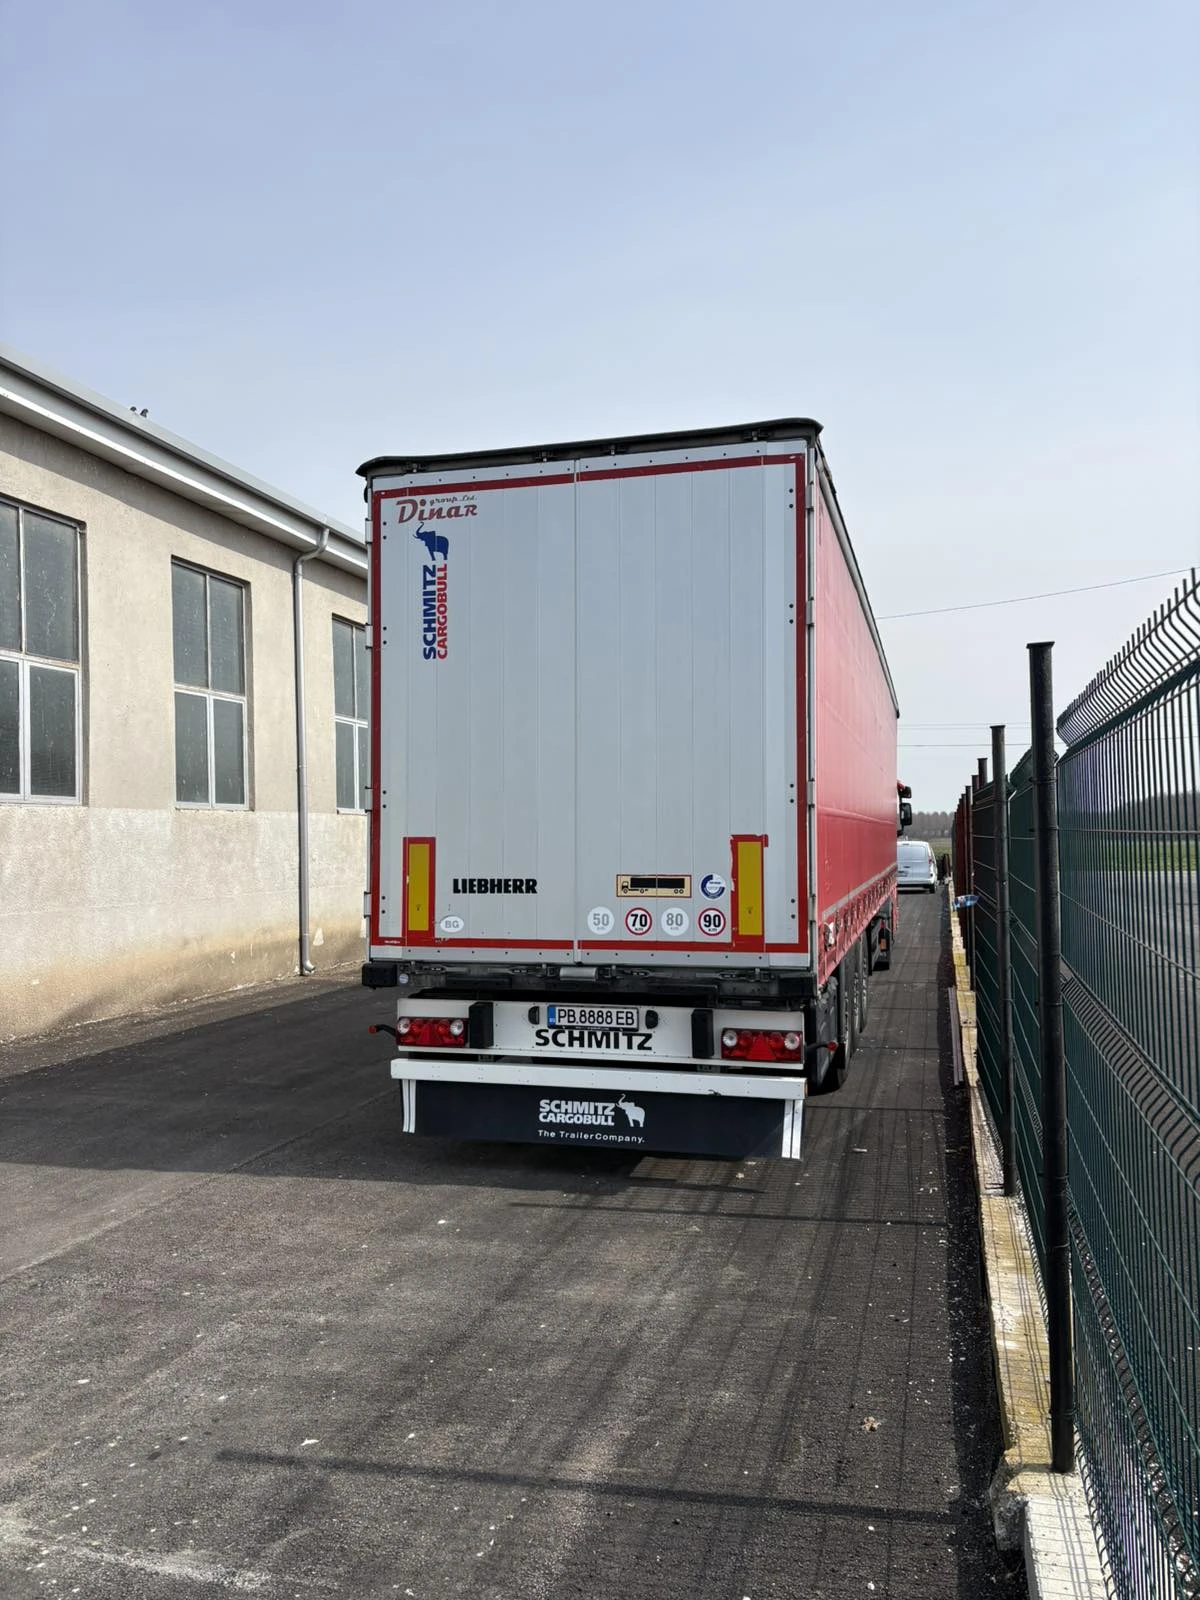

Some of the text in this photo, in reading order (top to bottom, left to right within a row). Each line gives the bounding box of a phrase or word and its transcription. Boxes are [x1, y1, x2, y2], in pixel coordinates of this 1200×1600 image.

[422, 564, 437, 660] SCHMITZ
[436, 563, 448, 660] CARGOBULL
[452, 878, 538, 894] LIEBHERR
[444, 920, 460, 929] BG
[592, 912, 610, 927] 50
[630, 913, 648, 928] 70
[666, 912, 684, 927] 80
[703, 913, 721, 928] 90
[535, 1028, 653, 1051] SCHMITZ
[539, 1099, 616, 1116] SCHMITZ
[538, 1112, 615, 1126] CARGOBULL
[538, 1129, 556, 1138] The
